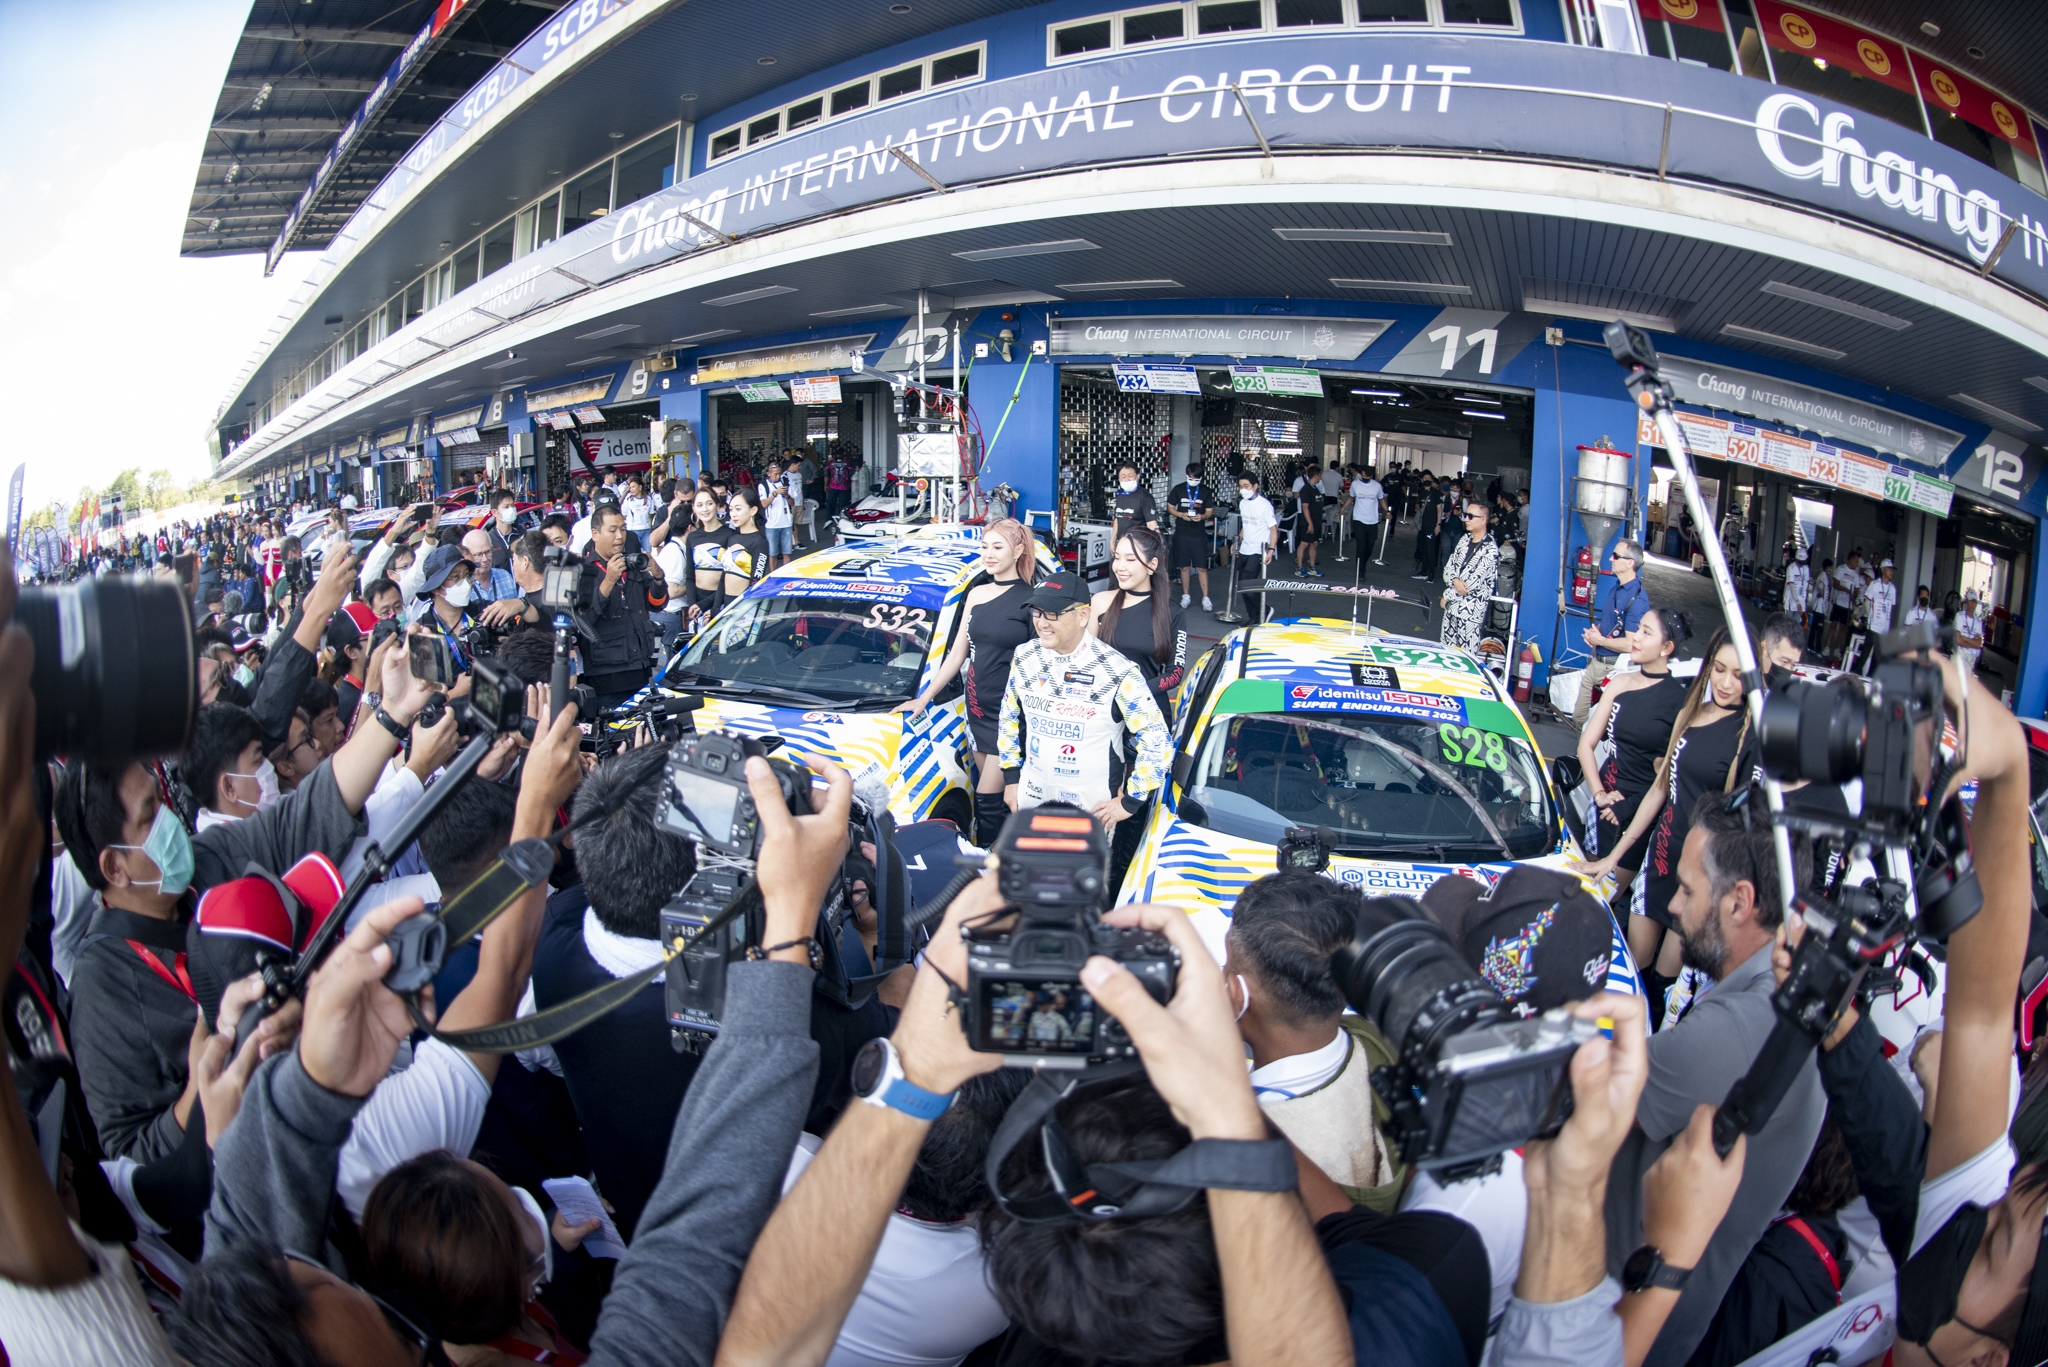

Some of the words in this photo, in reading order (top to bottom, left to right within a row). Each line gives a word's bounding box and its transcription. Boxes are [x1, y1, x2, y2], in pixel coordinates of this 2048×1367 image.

[543, 0, 598, 61] SCB
[1786, 21, 1809, 39] CP
[1863, 48, 1884, 66] CP
[1936, 79, 1955, 97] CP
[461, 75, 500, 130] SCB
[1996, 111, 2013, 130] CP
[406, 137, 433, 183] SCB
[612, 187, 728, 264] Chang
[739, 85, 1134, 214] INTERNATIONAL
[1159, 64, 1472, 123] CIRCUIT
[1756, 93, 2002, 266] Chang
[481, 264, 542, 316] CIRCUIT
[897, 326, 948, 364] 10
[1084, 326, 1129, 343] Chang
[1134, 328, 1232, 340] INTERNATIONAL
[1238, 329, 1292, 341] CIRCUIT
[1427, 325, 1498, 374] 11
[714, 359, 736, 372] Chang
[738, 355, 788, 368] INTERNATIONAL
[790, 351, 820, 362] CIRCUIT
[631, 368, 648, 395] 9
[1118, 375, 1149, 390] 232
[1233, 376, 1266, 391] 328
[793, 388, 811, 403] 599
[1697, 372, 1746, 401] Chang
[1751, 388, 1844, 423] INTERNATIONAL
[1848, 414, 1894, 437] CIRCUIT
[493, 401, 503, 421] 8
[1640, 420, 1666, 445] 51
[607, 436, 650, 457] idemi
[1728, 437, 1758, 462] 520
[1810, 456, 1838, 482] 523
[1975, 443, 2024, 501] 12
[1885, 478, 1911, 500] 317
[1094, 542, 1104, 559] 32
[754, 553, 768, 580] ROOKIE
[800, 581, 847, 591] idemitsu
[809, 591, 878, 601] ENDURANCE
[1264, 579, 1329, 590] ROOKIE
[1330, 585, 1400, 598] RACING
[862, 603, 927, 635] S32
[1174, 629, 1187, 667] ROOKIE
[1380, 647, 1470, 672] 328
[1318, 685, 1381, 701] idemitsu
[1023, 694, 1054, 713] ROOKIE
[1055, 702, 1097, 720] RACING
[1292, 700, 1338, 709] SUPER
[1341, 702, 1430, 717] ENDURANCE
[1432, 711, 1461, 722] 2022
[1039, 726, 1080, 739] CLUTCH
[1040, 719, 1081, 732] OGURA
[1606, 702, 1621, 759] ROOKIE
[1439, 723, 1509, 772] S28
[1669, 737, 1687, 804] ROOKIE
[1654, 804, 1674, 877] RACING
[1367, 869, 1434, 881] OGUR
[1368, 879, 1433, 890] CLUTC
[680, 1013, 697, 1023] TBS
[697, 1017, 721, 1027] NEWS
